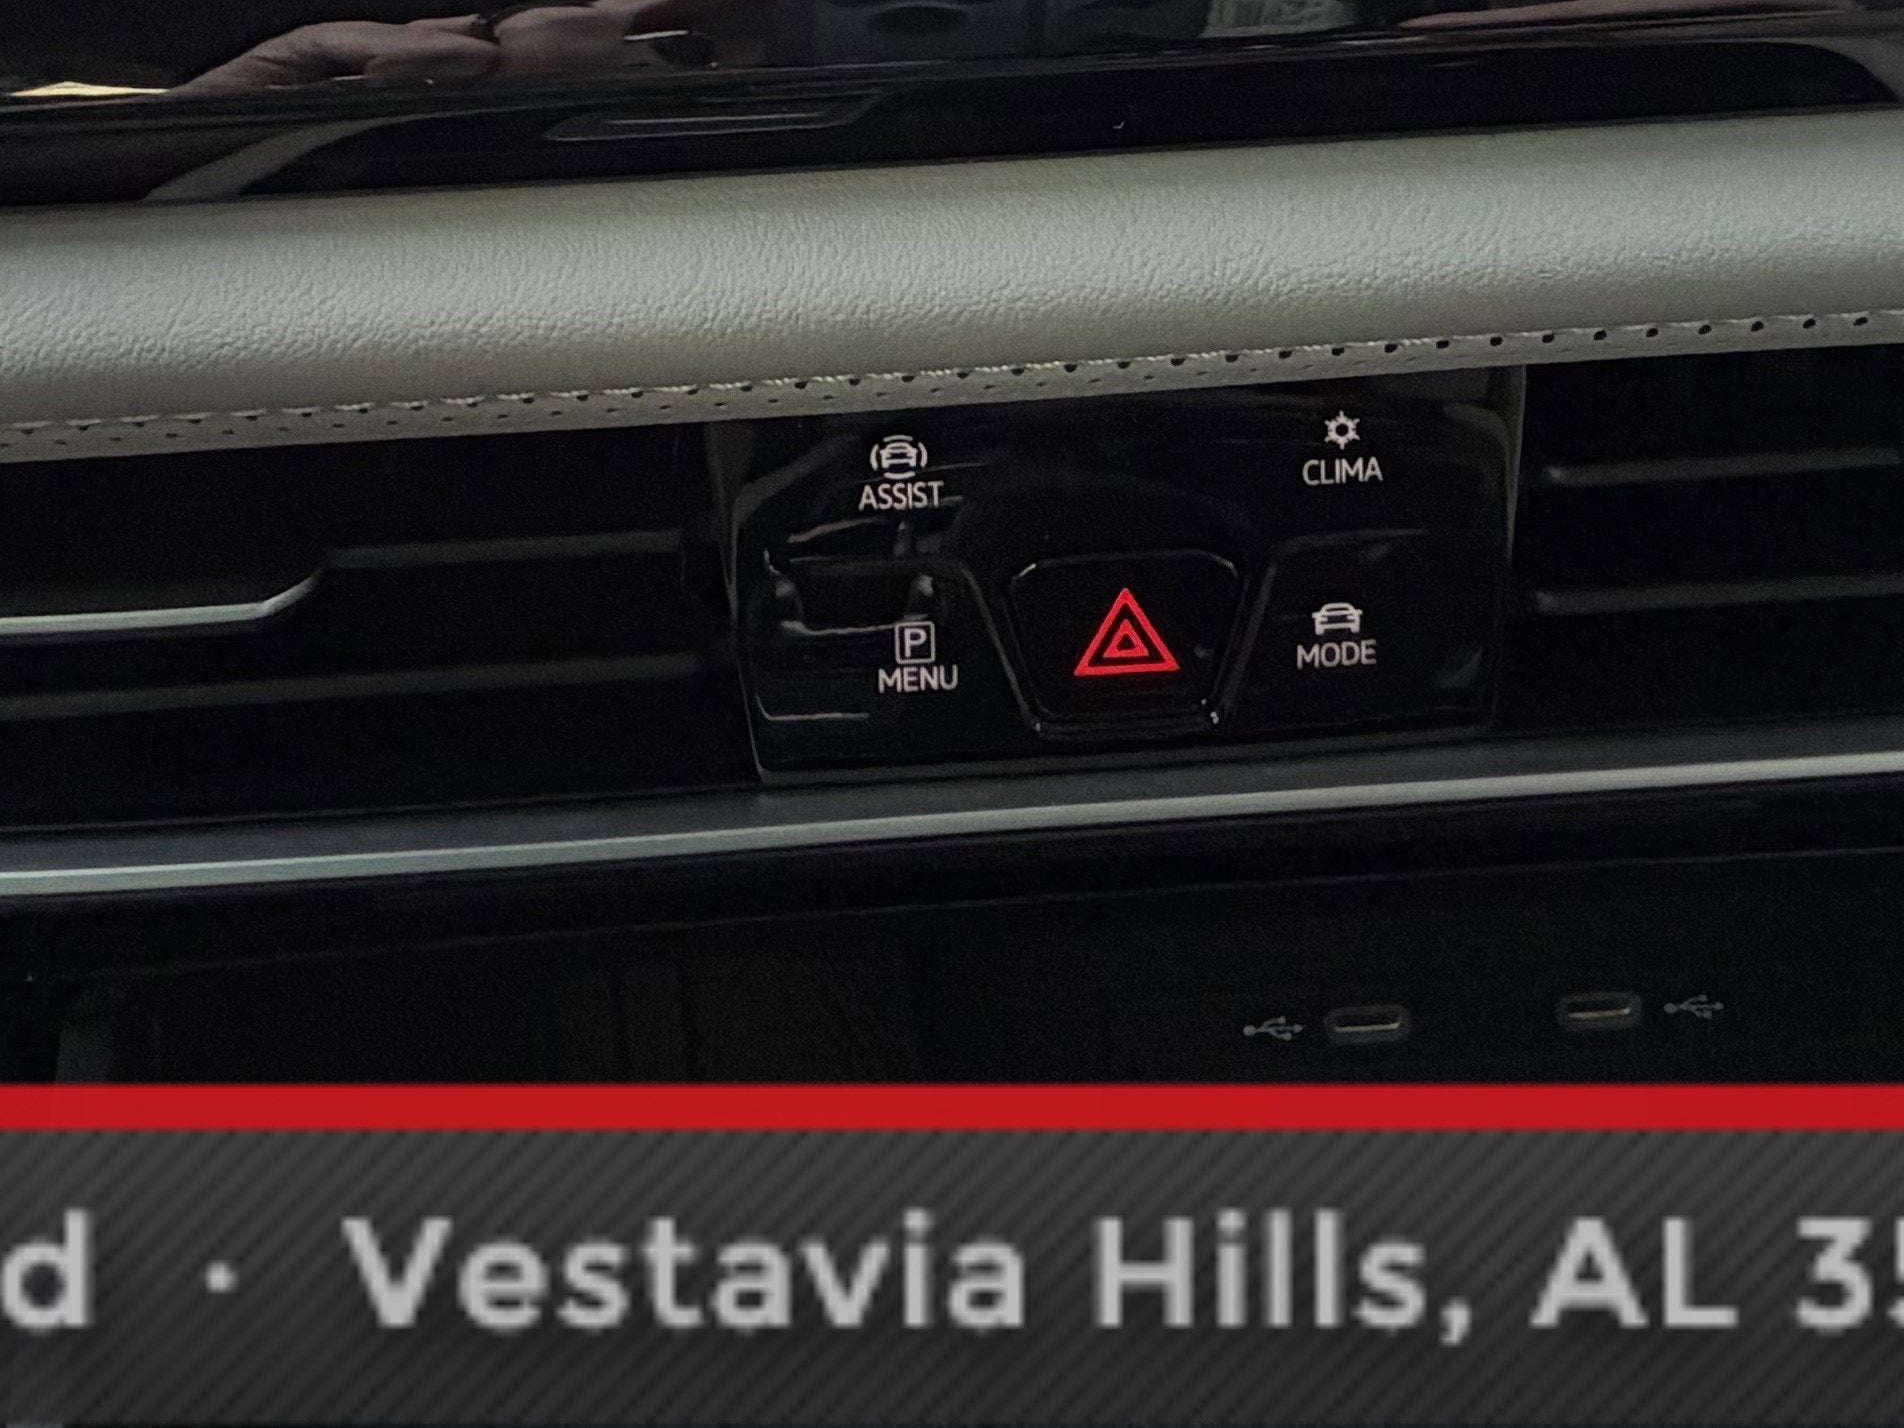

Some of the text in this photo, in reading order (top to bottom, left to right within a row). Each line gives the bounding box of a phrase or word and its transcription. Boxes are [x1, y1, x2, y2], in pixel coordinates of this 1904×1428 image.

[1303, 456, 1383, 487] CLIMA
[859, 481, 944, 511] ASSIST
[903, 628, 928, 659] P
[1297, 640, 1378, 670] MODE
[878, 664, 959, 694] MENU
